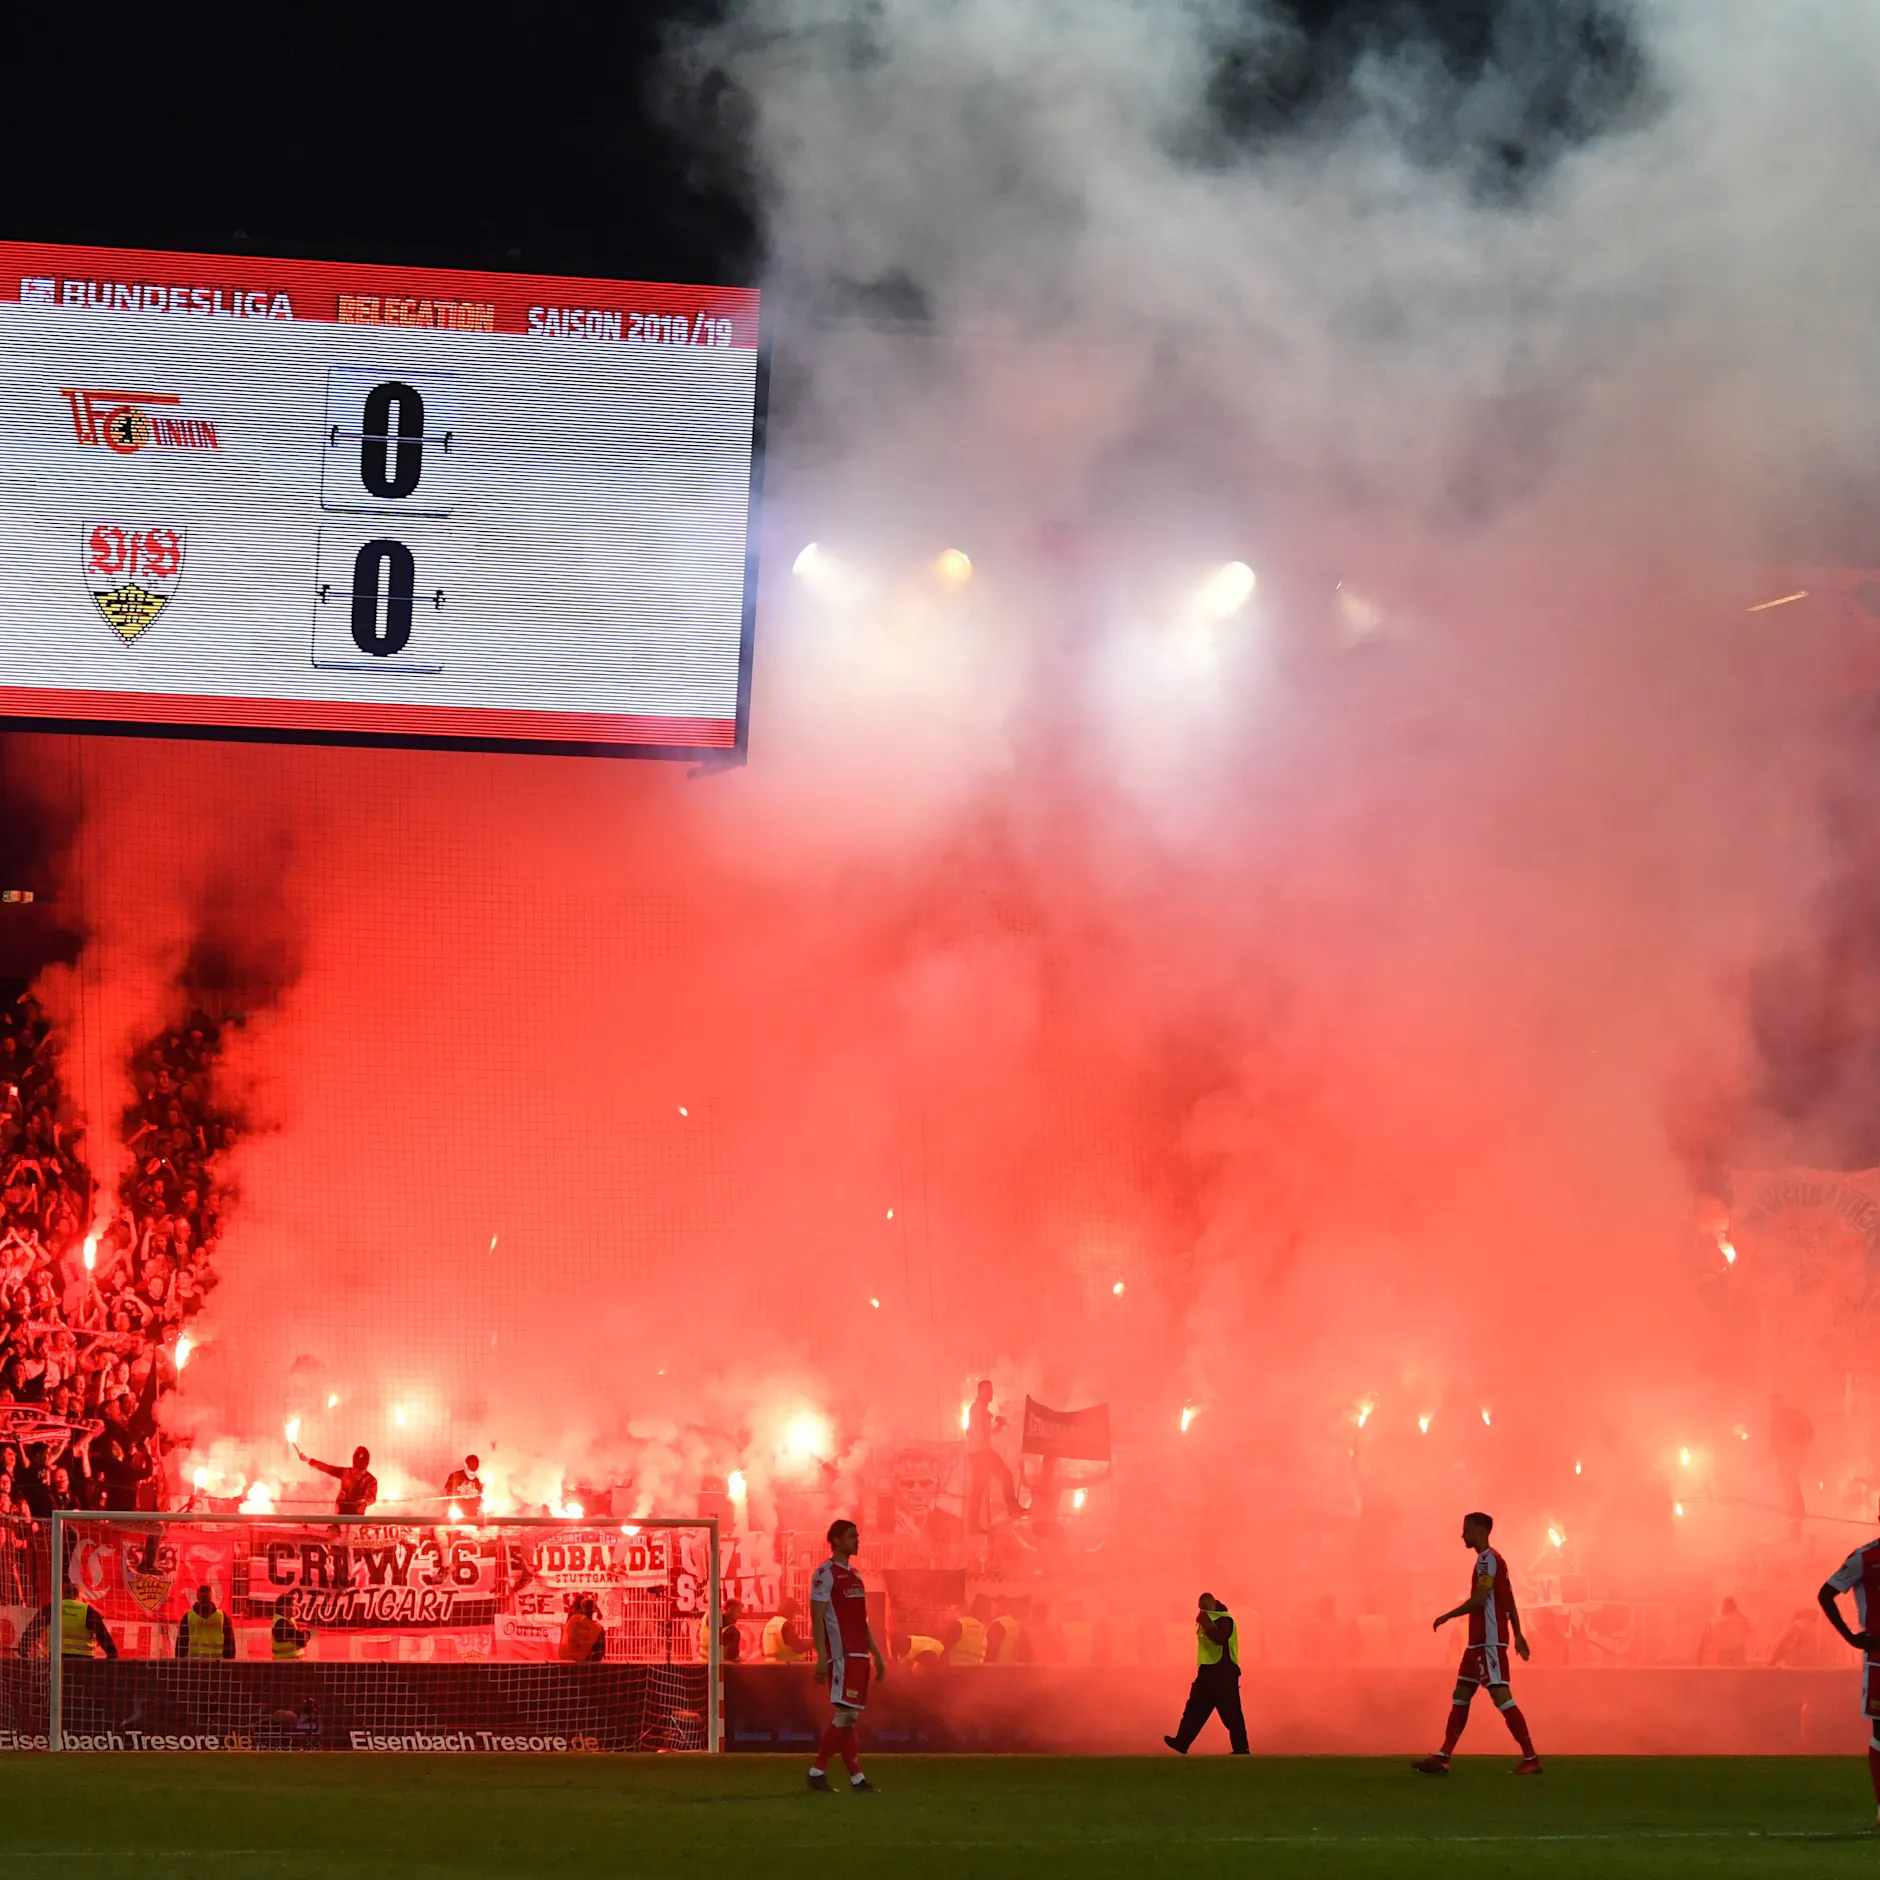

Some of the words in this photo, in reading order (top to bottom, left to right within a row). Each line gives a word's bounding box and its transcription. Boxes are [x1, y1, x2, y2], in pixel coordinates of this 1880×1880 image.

[62, 279, 294, 321] BUNDESLIGA
[527, 307, 622, 342] SAISON
[627, 311, 733, 348] 2018/19
[152, 417, 218, 449] UNION
[361, 381, 424, 499] 0
[351, 538, 415, 658] 0
[350, 1731, 474, 1751] Eisenbach
